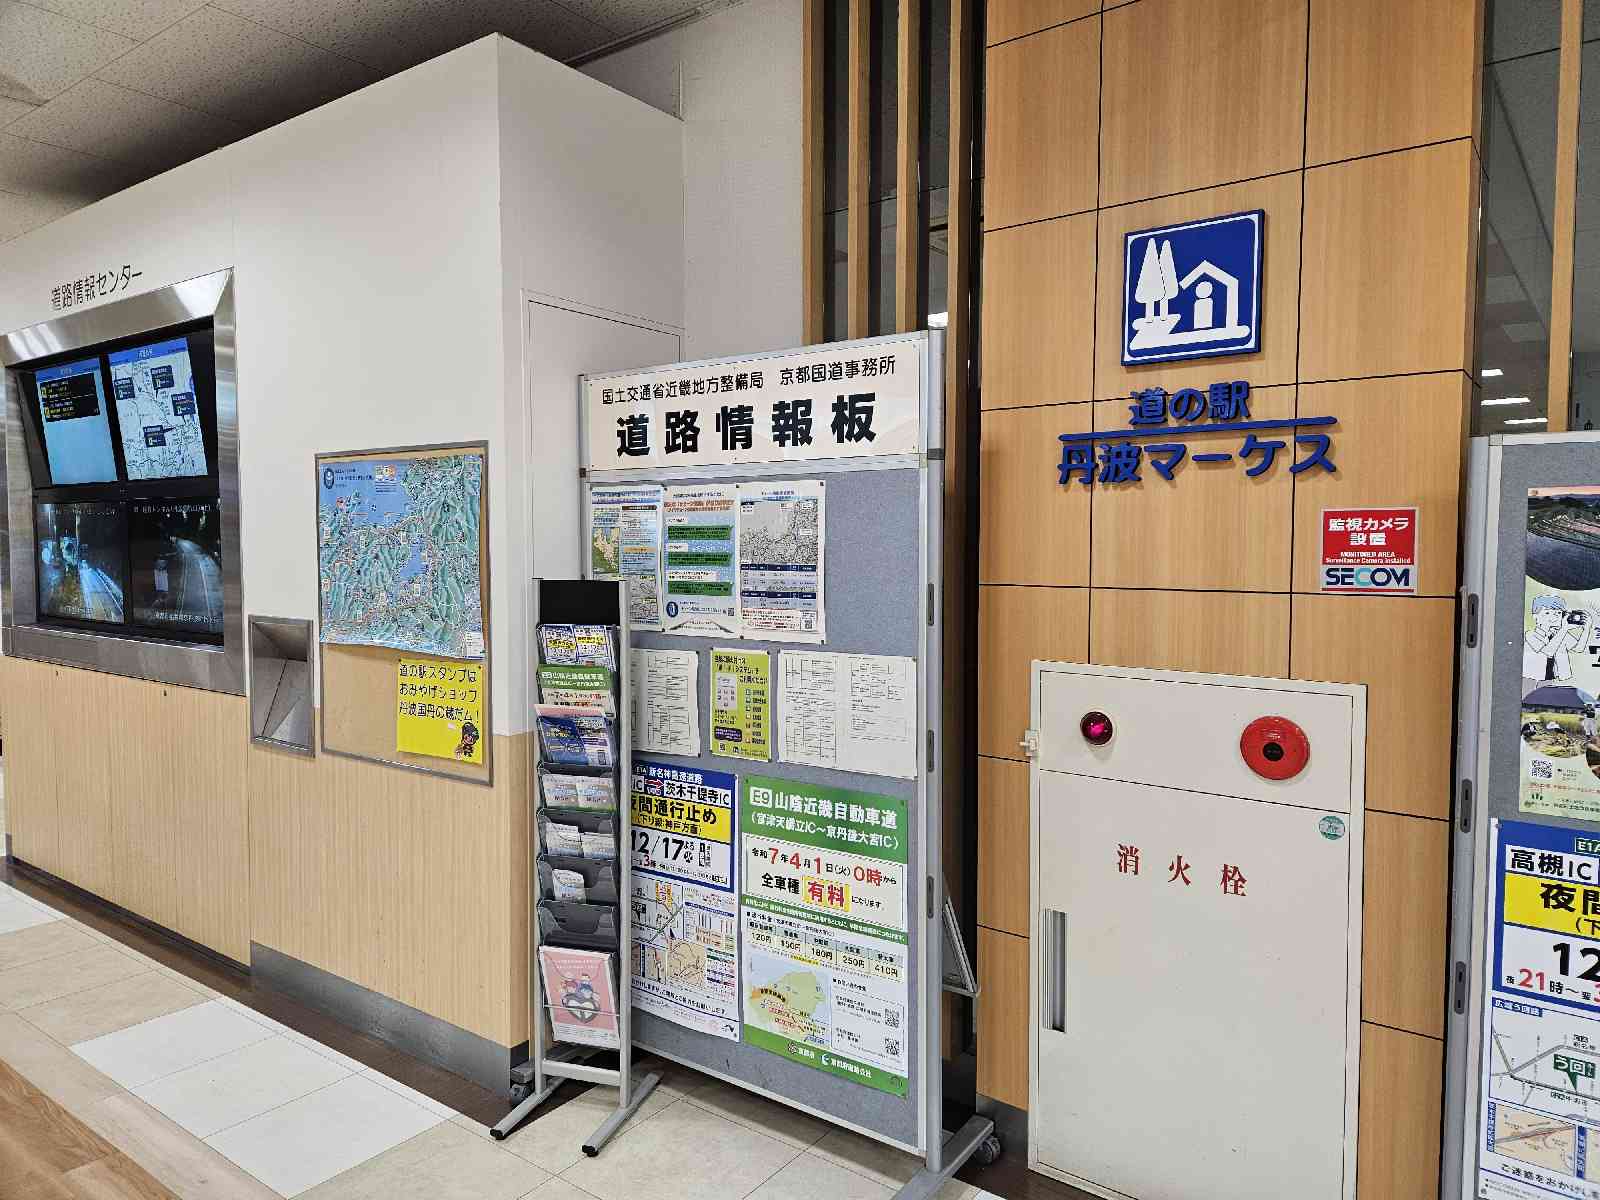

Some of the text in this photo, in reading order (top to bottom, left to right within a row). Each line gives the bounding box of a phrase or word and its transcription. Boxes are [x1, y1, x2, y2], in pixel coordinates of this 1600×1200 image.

[51, 264, 143, 312] 道路情報センター
[602, 354, 897, 406] 国土交通省近畿地方整備局 京都国道事務所
[1128, 381, 1251, 426] 道の駅
[616, 392, 877, 457] 道路情報板
[1057, 433, 1337, 485] 丹波マーケス
[1328, 517, 1409, 532] 監視カメラ
[1349, 532, 1387, 546] 設置
[1325, 567, 1410, 587] SECOM
[400, 664, 477, 683] 道の駅スタンプは
[400, 683, 478, 703] おみやげショップ
[753, 789, 898, 829] E9 山陰近畿自動車道
[1117, 843, 1248, 897] 消火栓
[1511, 849, 1592, 881] 高槻IC
[761, 873, 800, 895] 全車種
[807, 880, 845, 908] 有料
[811, 947, 833, 961] 180円
[843, 955, 865, 969] 250円
